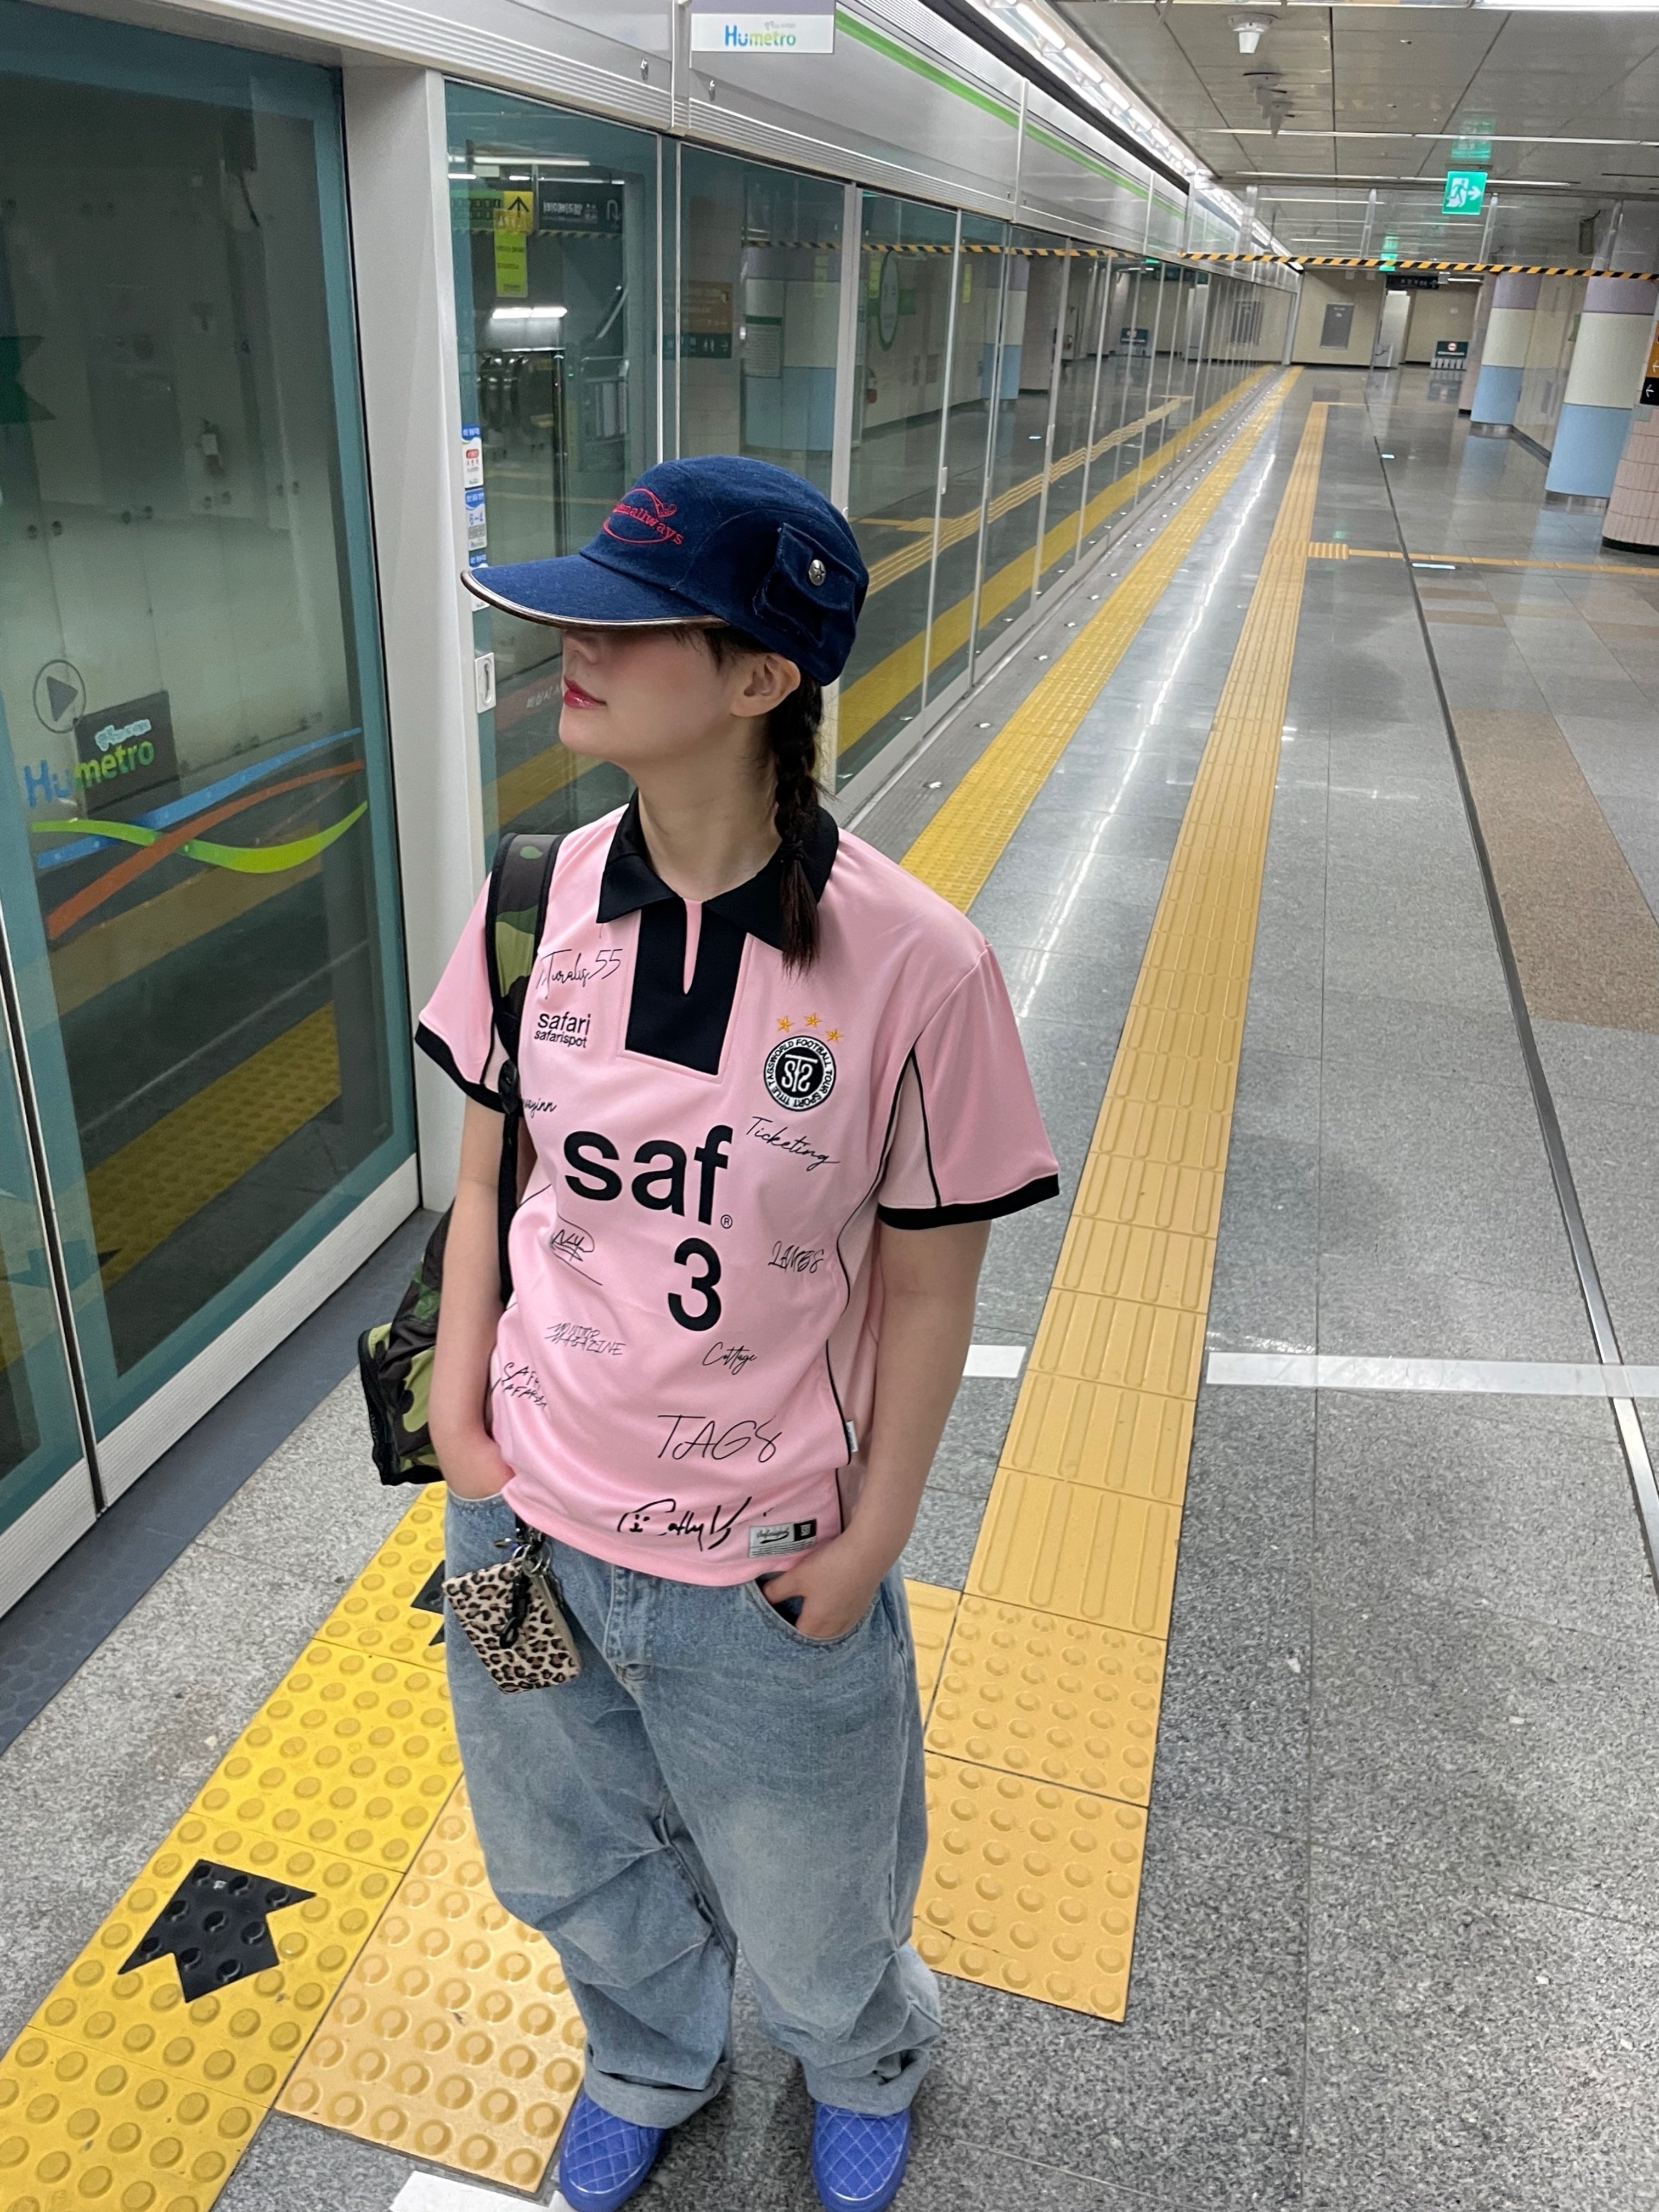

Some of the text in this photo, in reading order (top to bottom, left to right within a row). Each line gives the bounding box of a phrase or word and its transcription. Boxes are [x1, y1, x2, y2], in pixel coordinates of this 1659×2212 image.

[724, 25, 796, 46] Humetro
[24, 741, 154, 808] Humetro
[534, 1030, 587, 1048] safarispot
[538, 1012, 591, 1035] safari
[795, 1039, 832, 1068] FOOTBALL
[771, 1086, 790, 1105] TITLE
[820, 1070, 833, 1094] TOUR
[746, 1116, 840, 1171] Ticketing
[563, 1125, 733, 1226] saf
[668, 1238, 721, 1331] 3
[702, 1341, 757, 1375] Cottage
[657, 1414, 782, 1463] TAGS
